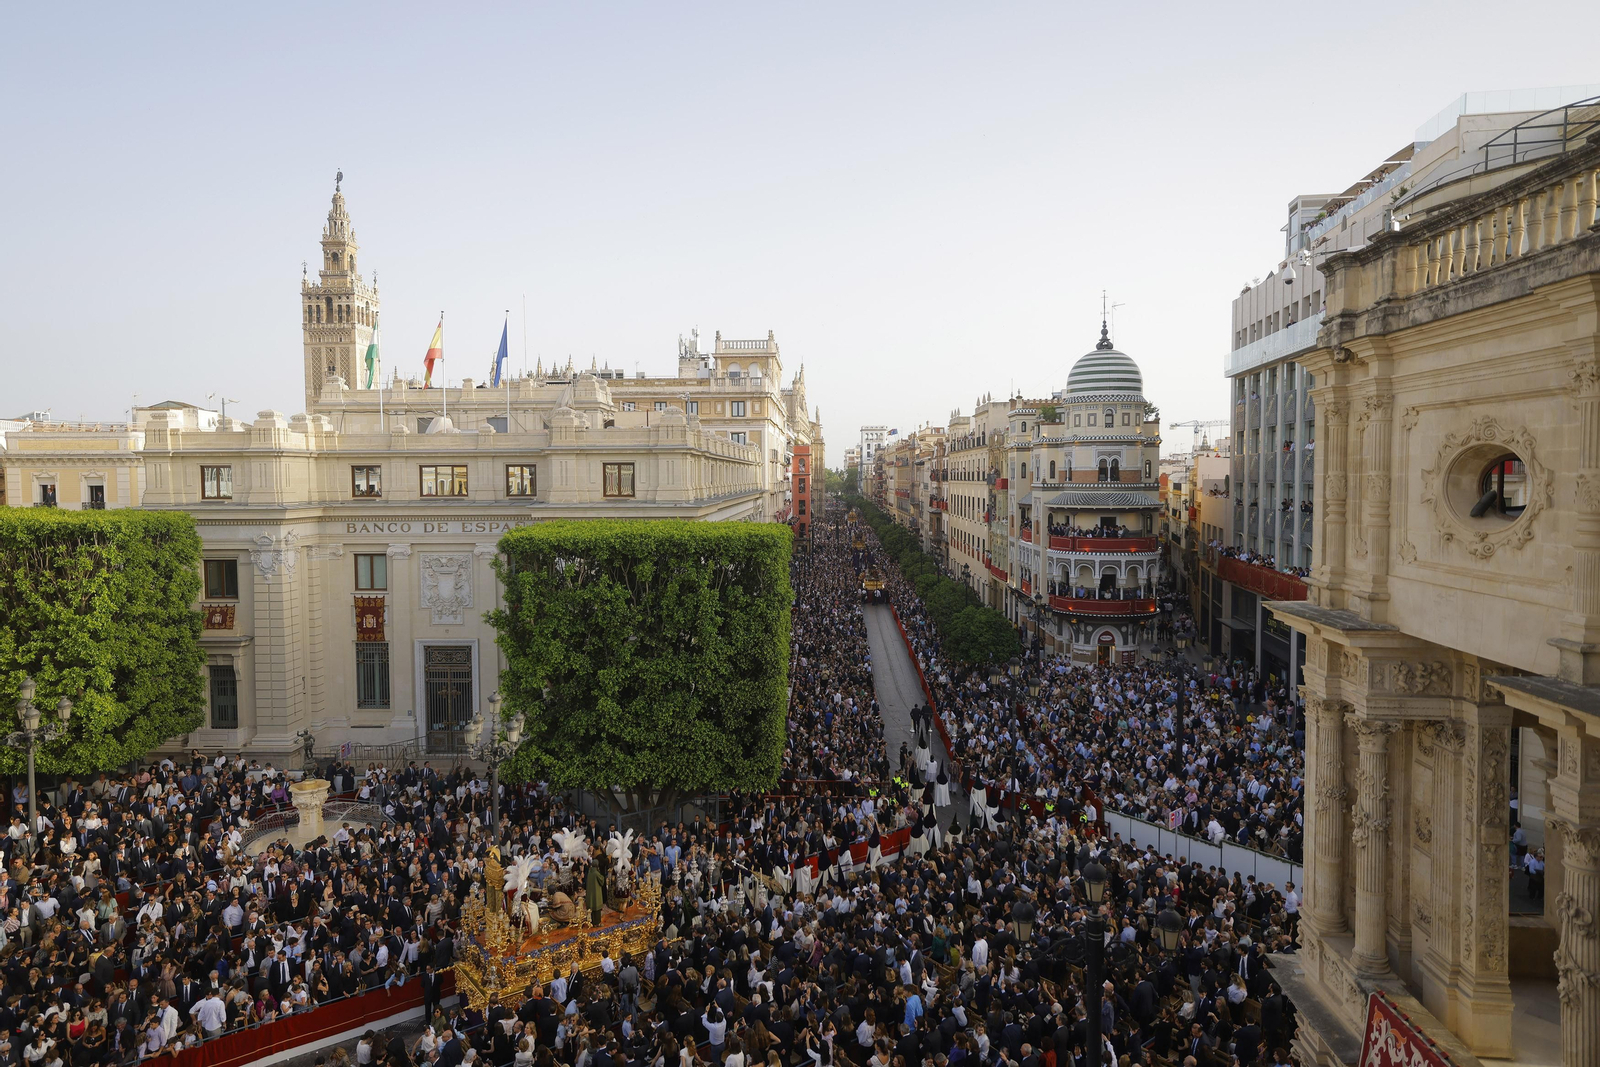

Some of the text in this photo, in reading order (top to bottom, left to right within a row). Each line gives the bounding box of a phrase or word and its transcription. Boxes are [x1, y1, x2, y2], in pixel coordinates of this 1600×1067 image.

[347, 520, 535, 533] BANCO DE ESPA
